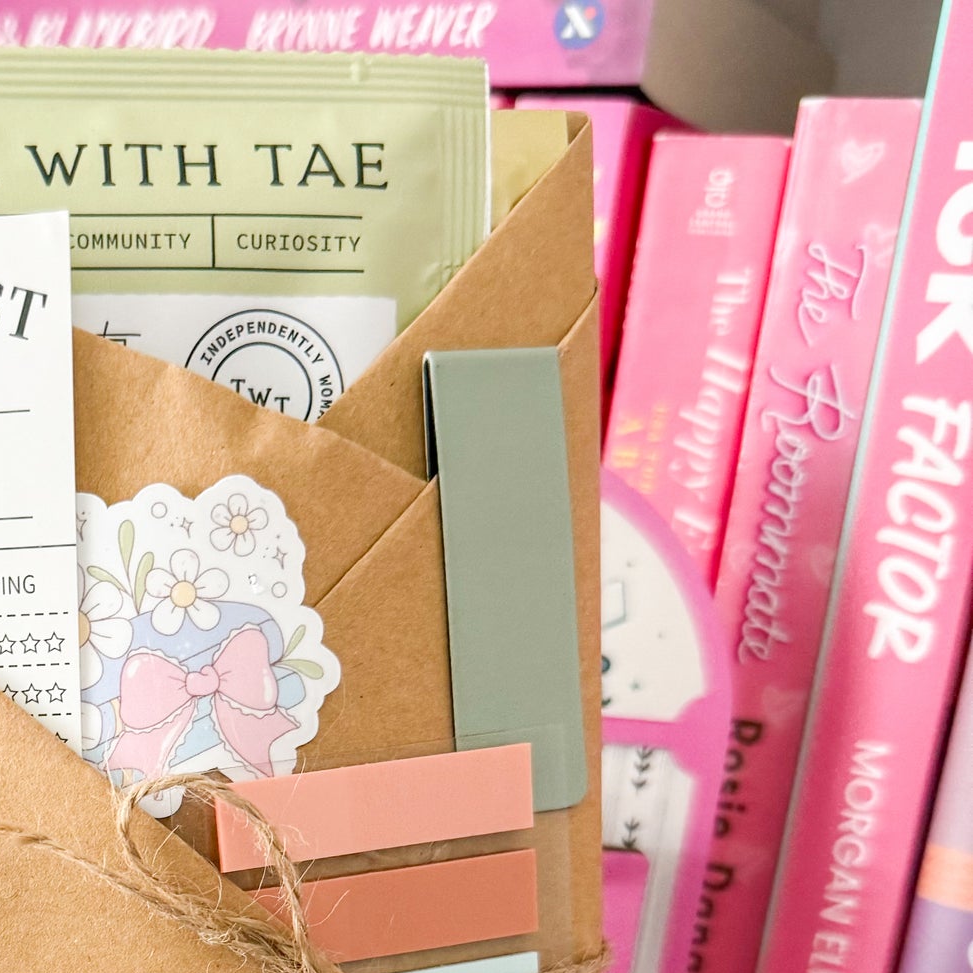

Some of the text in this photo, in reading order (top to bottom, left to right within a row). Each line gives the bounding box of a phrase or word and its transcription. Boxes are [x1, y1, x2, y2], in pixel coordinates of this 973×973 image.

[246, 2, 496, 50] BRYNNE WEAVER
[25, 143, 222, 188] WITH
[255, 143, 389, 190] TAE
[236, 233, 361, 253] CURIOSITY
[710, 267, 753, 337] The
[200, 321, 324, 366] INDEPENDENTLY
[668, 345, 749, 501] Happy
[738, 241, 869, 664] The Roommate
[863, 394, 972, 664] FACTOR
[820, 739, 898, 925] MORGAN
